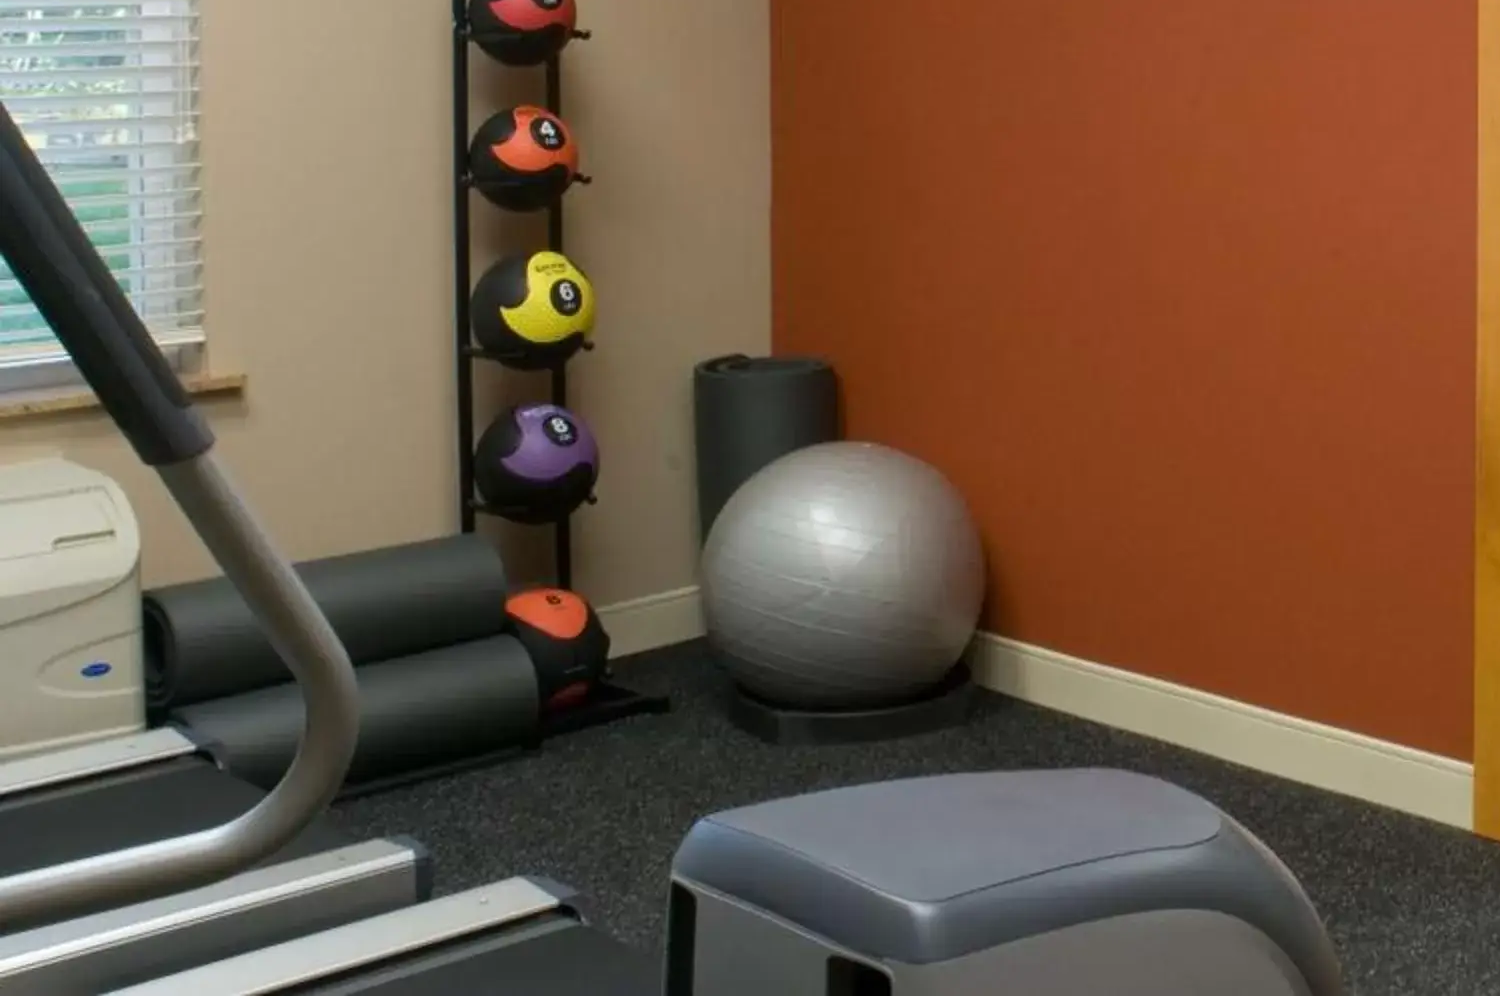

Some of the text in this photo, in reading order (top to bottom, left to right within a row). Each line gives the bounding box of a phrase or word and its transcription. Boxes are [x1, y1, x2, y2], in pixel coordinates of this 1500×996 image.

[540, 120, 556, 136] 4
[559, 282, 576, 301] 6
[551, 417, 569, 434] 8
